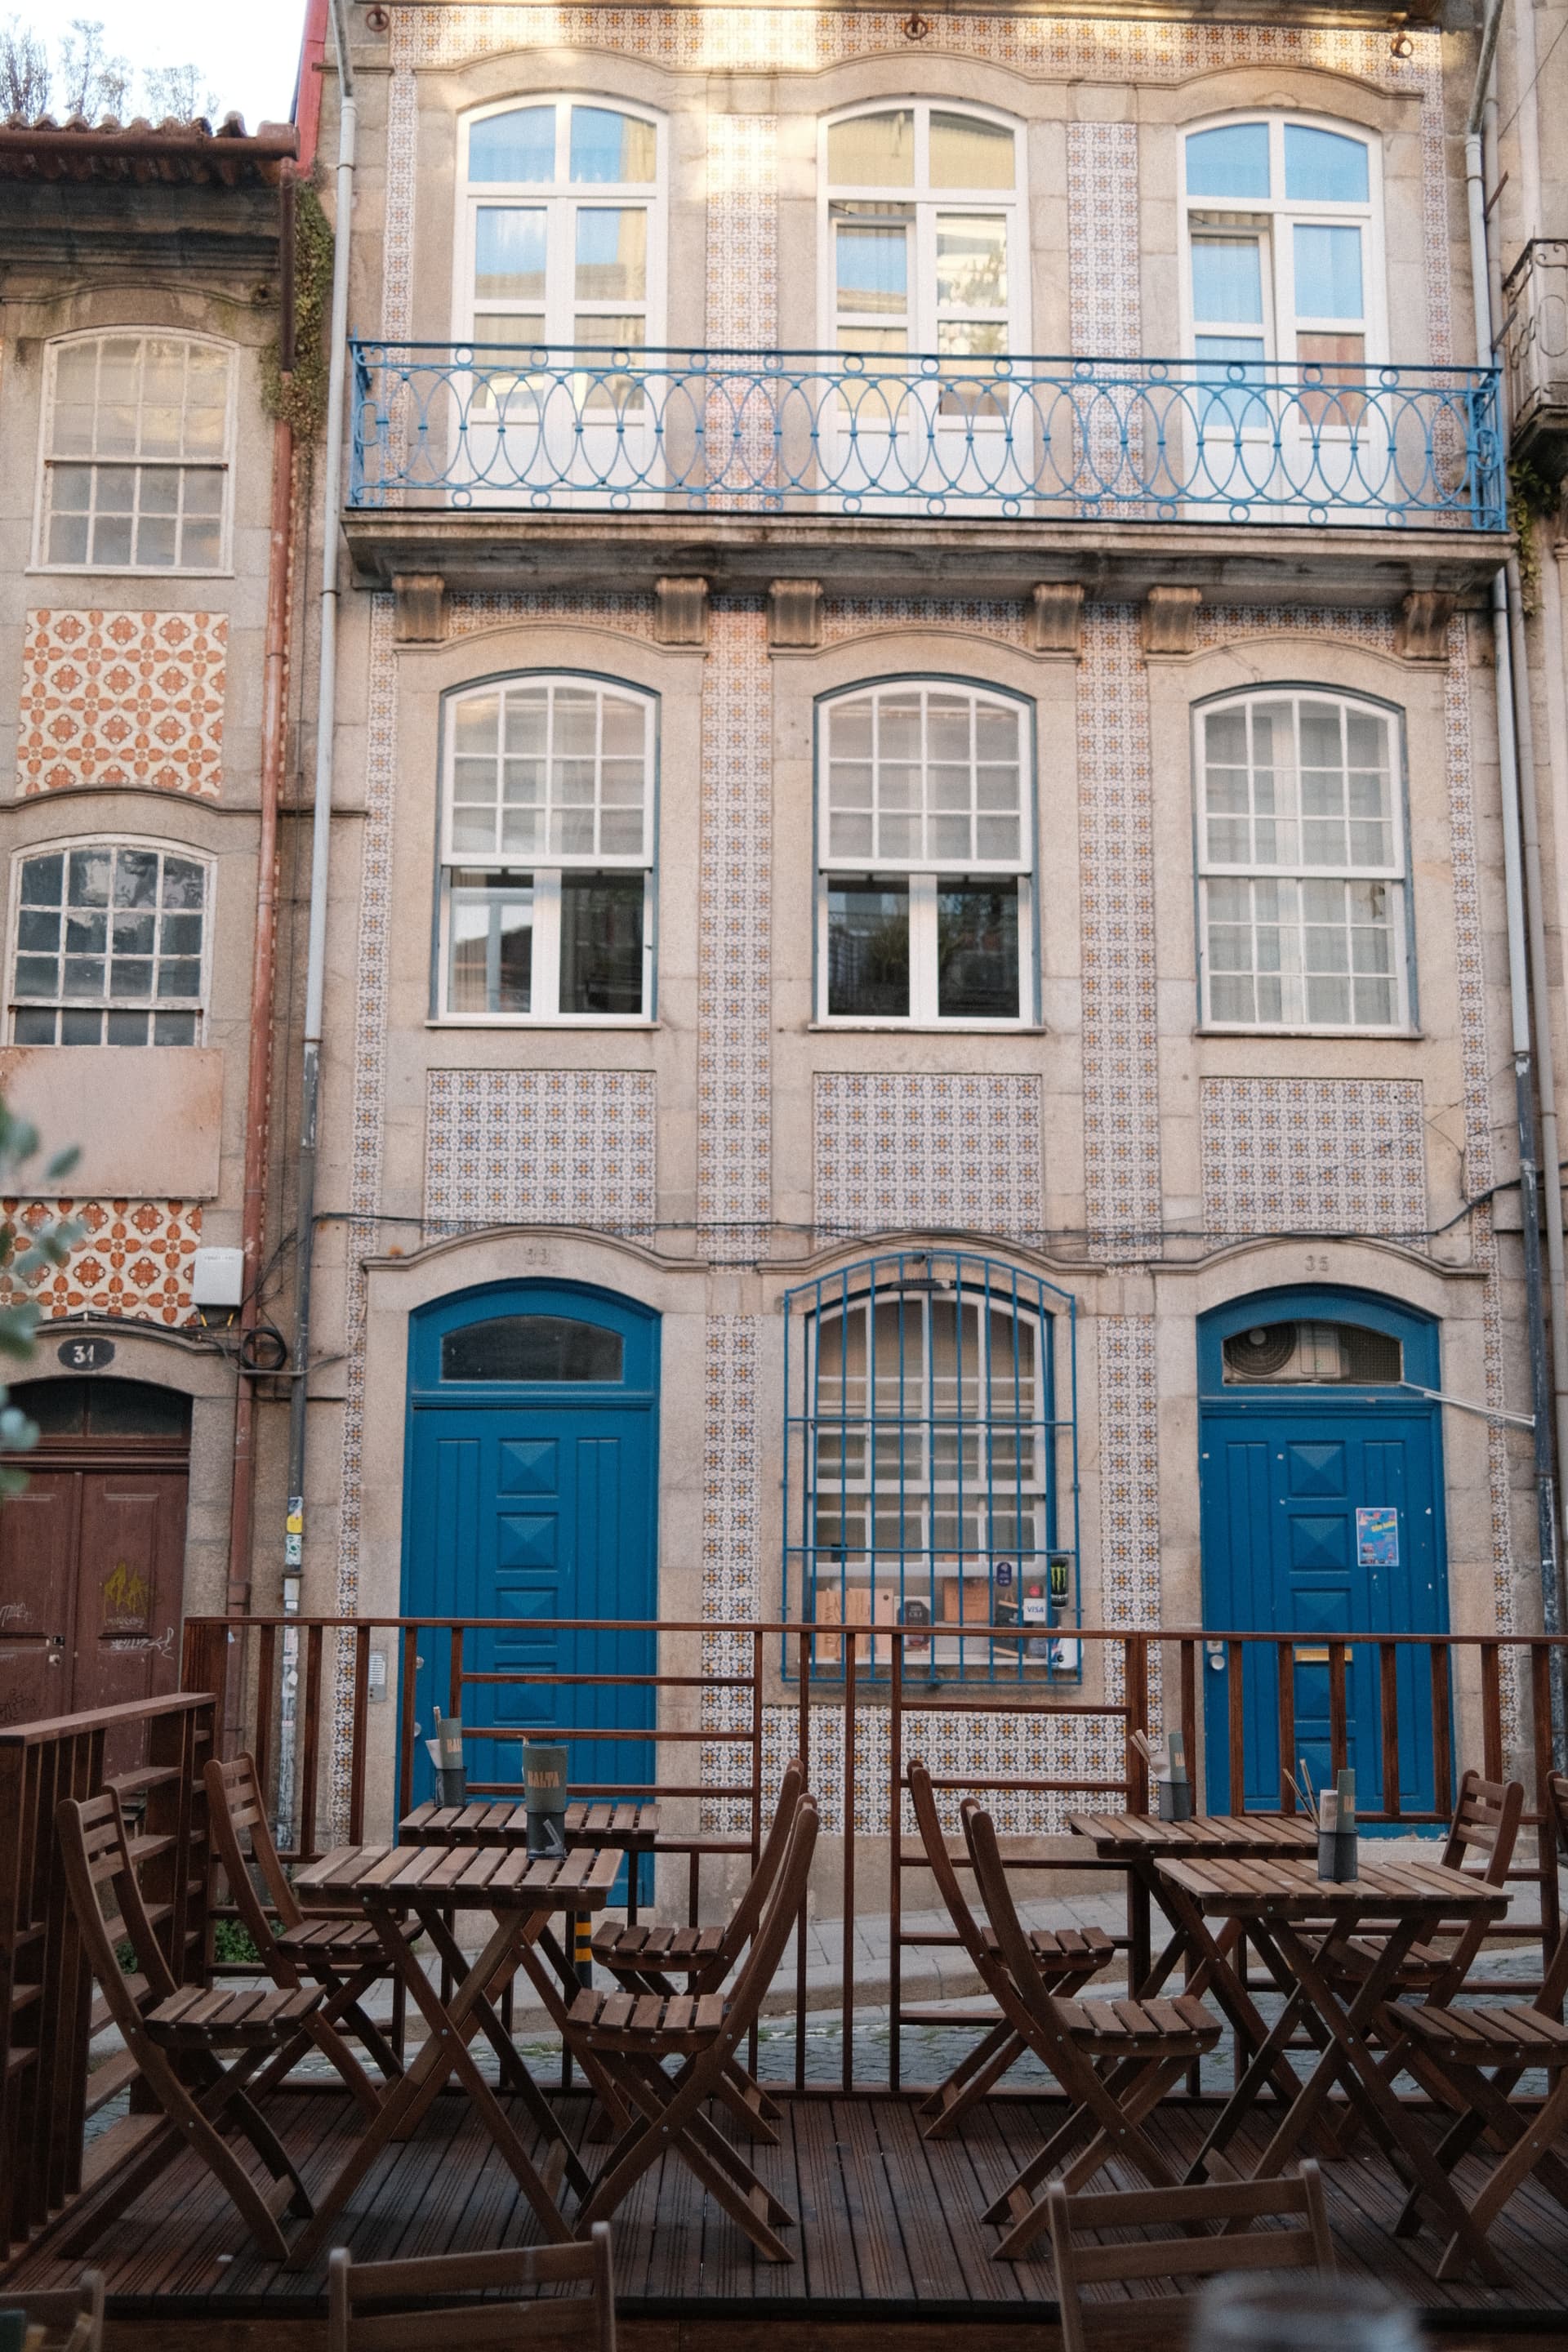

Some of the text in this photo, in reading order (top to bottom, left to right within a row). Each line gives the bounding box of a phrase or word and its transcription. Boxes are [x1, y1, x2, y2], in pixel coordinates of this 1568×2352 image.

[1305, 1254, 1330, 1272] 35
[74, 1344, 95, 1364] 31
[528, 1770, 559, 1788] BALTA
